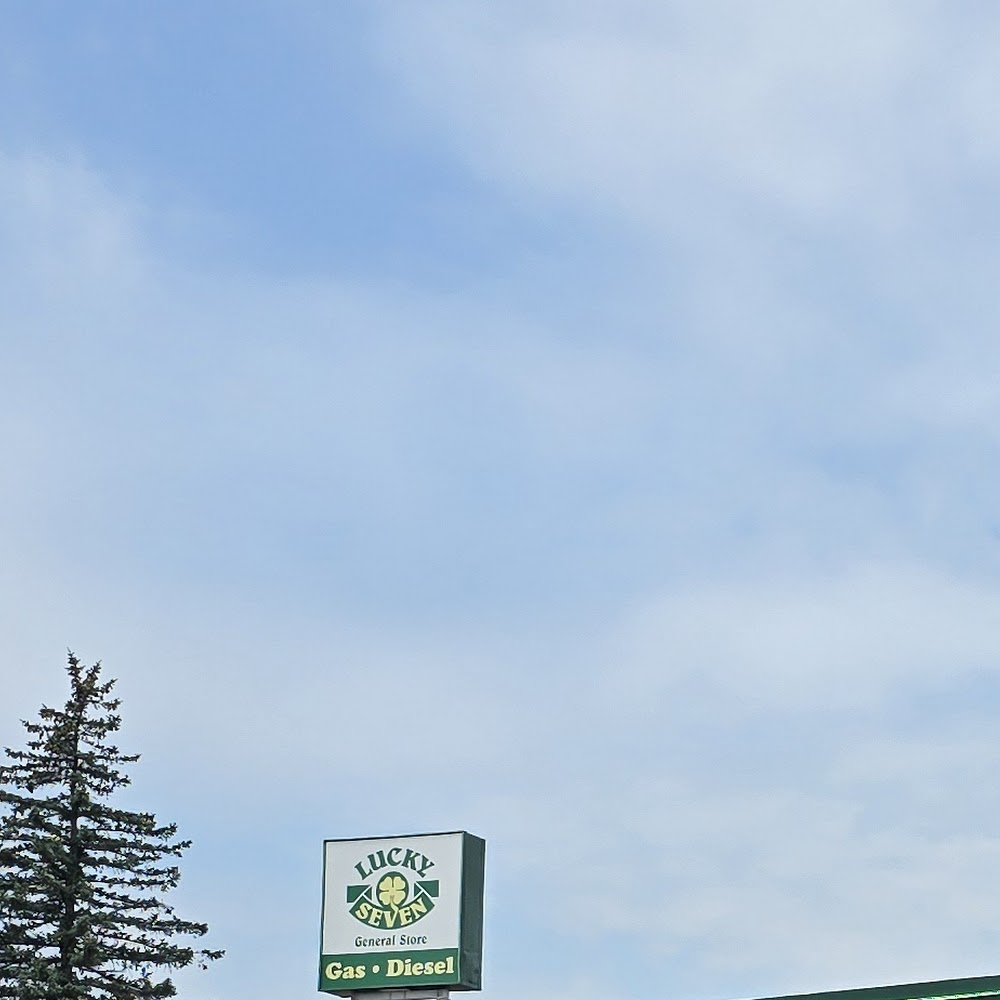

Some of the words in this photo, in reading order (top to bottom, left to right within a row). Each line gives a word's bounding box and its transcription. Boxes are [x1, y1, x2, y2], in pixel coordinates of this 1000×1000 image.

[354, 847, 435, 880] LUCKY
[355, 897, 428, 928] SEVEN
[355, 935, 396, 947] General
[400, 934, 428, 946] Store
[325, 961, 366, 980] Gas
[386, 956, 454, 977] Diesel
